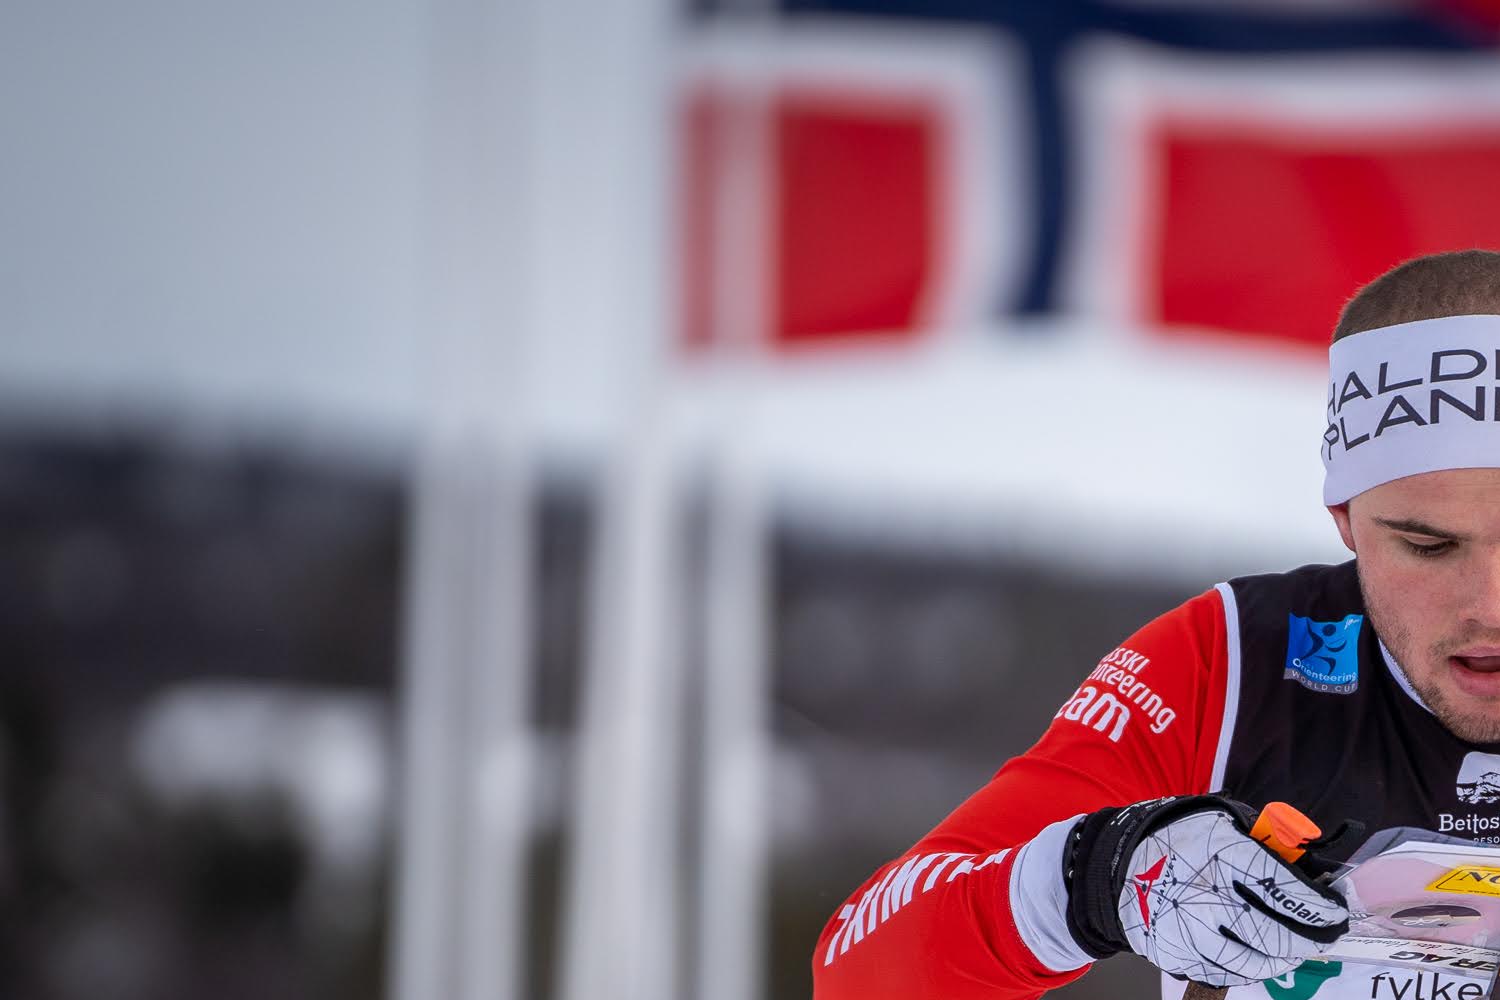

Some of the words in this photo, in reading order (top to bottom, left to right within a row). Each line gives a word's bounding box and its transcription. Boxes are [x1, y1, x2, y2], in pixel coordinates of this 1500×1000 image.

[1291, 669, 1329, 691] WORLD
[1292, 657, 1358, 682] Orienteering
[1256, 877, 1325, 925] Auclair
